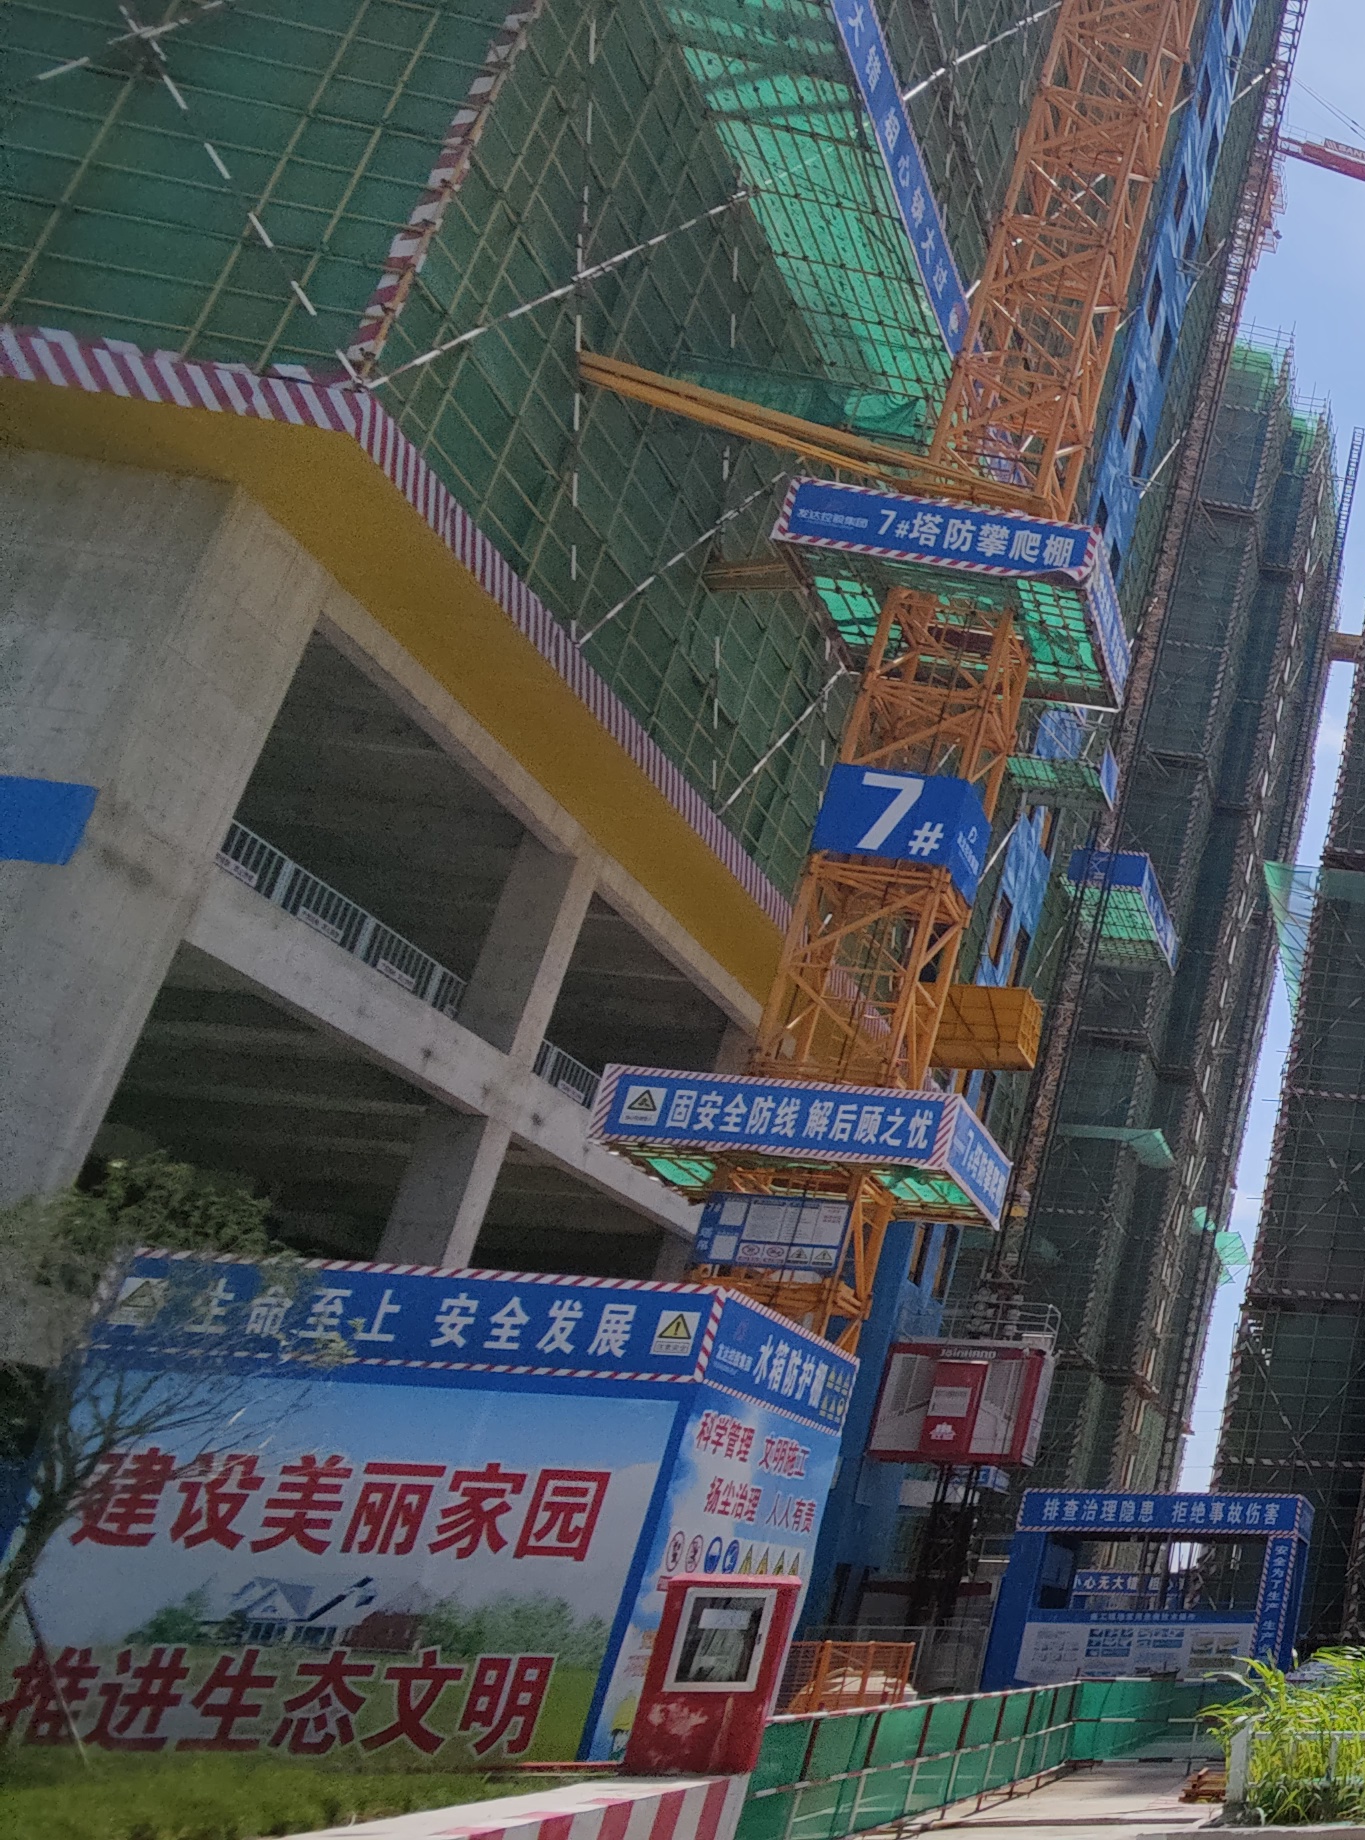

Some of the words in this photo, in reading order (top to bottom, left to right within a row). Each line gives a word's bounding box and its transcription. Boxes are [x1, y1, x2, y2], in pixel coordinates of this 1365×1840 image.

[877, 509, 1076, 569] 7#塔防攀爬棚
[856, 771, 944, 856] 7#
[664, 1088, 801, 1138] 固安全防线
[802, 1099, 933, 1150] 解后顾之忧
[183, 1278, 402, 1343] 生命至上
[430, 1292, 638, 1358] 安全发展
[752, 1334, 829, 1409] 水箱防护棚
[694, 1409, 756, 1463] 科学管理
[758, 1433, 810, 1479] 文明施工
[69, 1445, 611, 1563] 建设美丽家园
[703, 1475, 762, 1524] 扬尘治理
[765, 1491, 816, 1534] 人人有责
[1042, 1498, 1155, 1524] 排查治理隐患
[1171, 1500, 1281, 1526] 拒绝事故伤害
[1263, 1543, 1289, 1613] 安全为了生产
[0, 1644, 556, 1760] 推进生态文明
